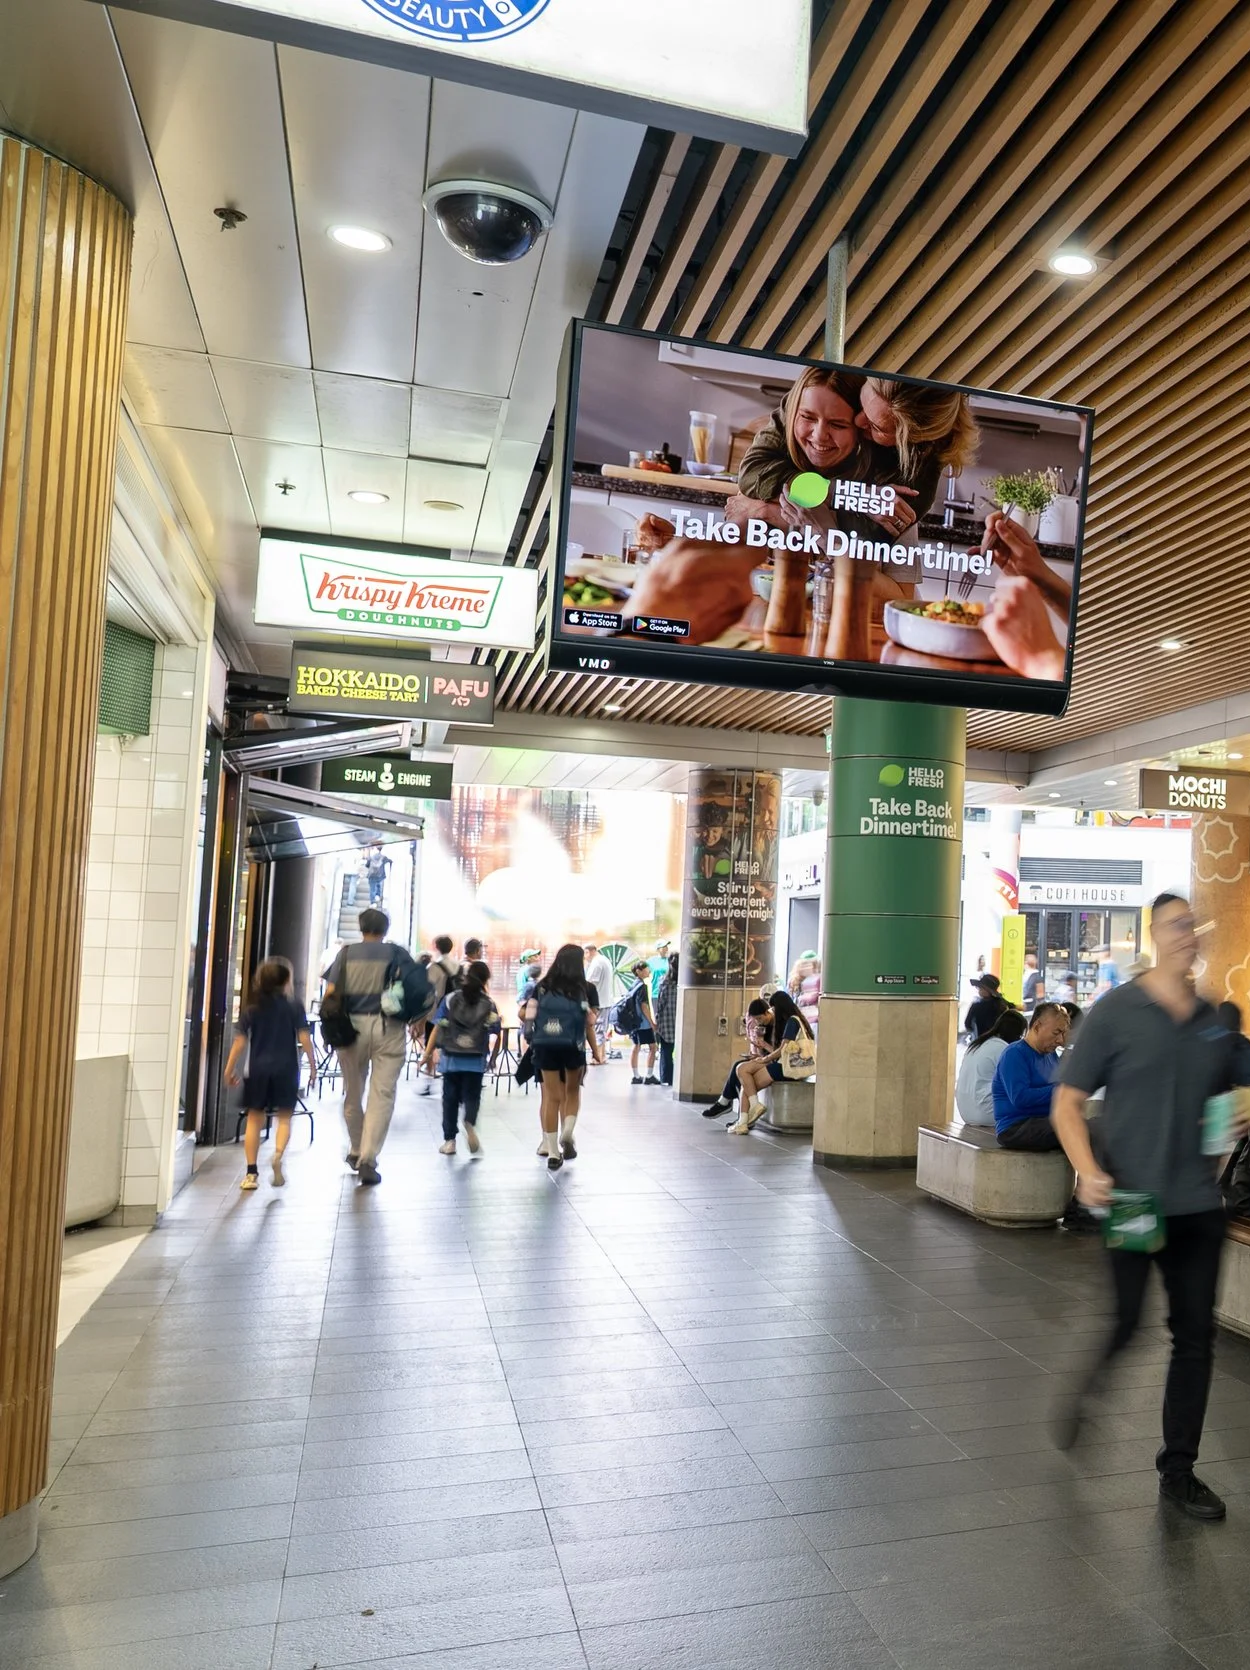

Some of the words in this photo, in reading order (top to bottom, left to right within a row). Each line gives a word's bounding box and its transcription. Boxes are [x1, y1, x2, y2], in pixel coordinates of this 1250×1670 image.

[836, 479, 896, 501] HELLO
[834, 498, 895, 517] FRESH
[670, 508, 740, 545] Take
[746, 518, 821, 555] Back
[827, 529, 994, 576] Dinnertime!
[316, 572, 407, 610] Krispy
[405, 581, 490, 613] Kreme
[346, 611, 454, 629] DOUGHNUTS
[582, 617, 597, 627] App
[598, 618, 618, 628] Store
[649, 623, 673, 633] Google
[673, 626, 686, 635] Play
[578, 657, 610, 669] VMO
[297, 666, 421, 692] HOKKAIDO
[433, 677, 489, 698] PAFU
[296, 684, 338, 697] BAKED
[341, 687, 388, 700] CHEESE
[389, 691, 420, 702] TART
[344, 769, 376, 782] STEAM
[397, 773, 431, 786] ENGINE
[908, 767, 944, 779] HELLO
[908, 777, 944, 789] FRESH
[1168, 774, 1226, 794] MOCHI
[869, 797, 911, 816] Take
[915, 799, 952, 819] Back
[1168, 791, 1226, 810] DONUTS
[860, 816, 957, 838] Dinnertime!
[717, 881, 741, 894] Stir
[1081, 888, 1125, 901] HOUSE
[691, 907, 720, 920] every
